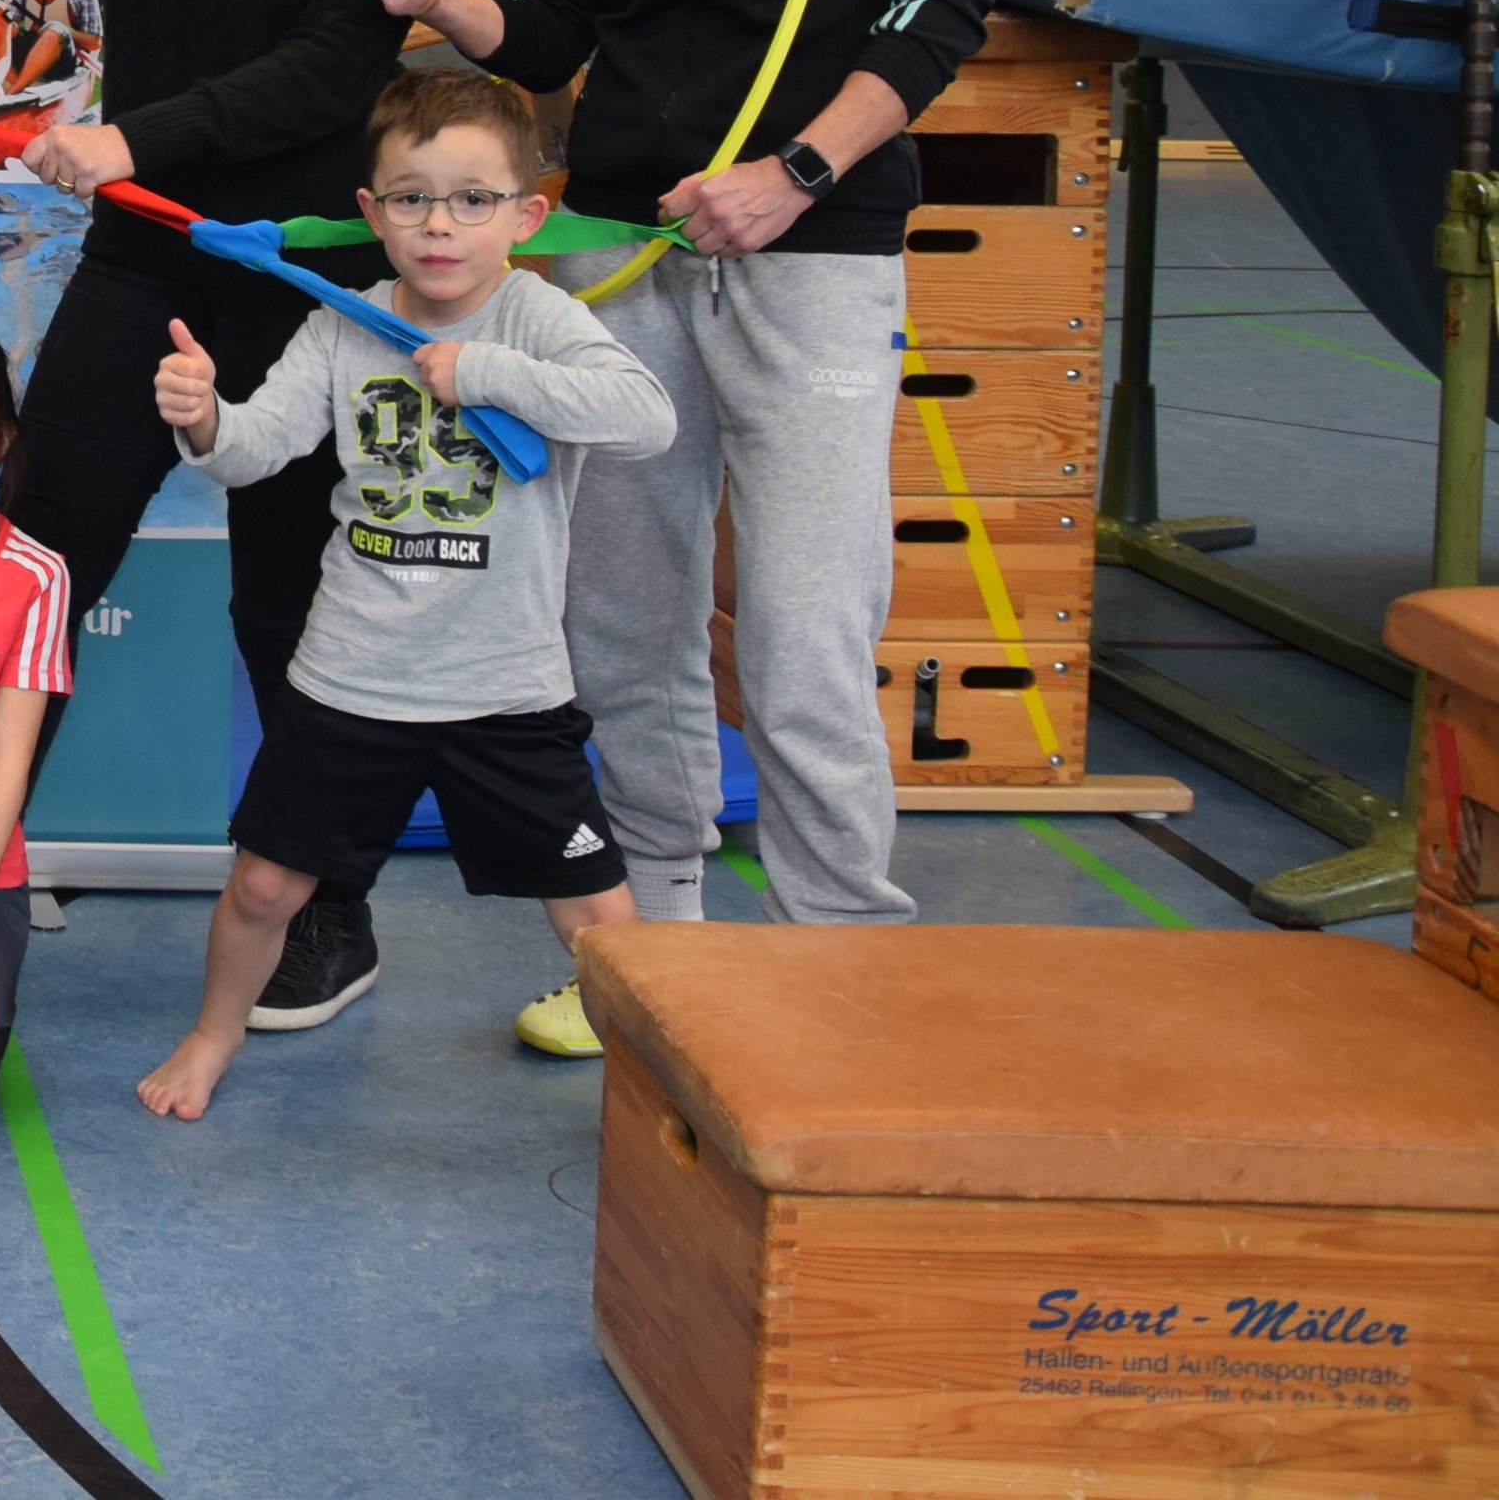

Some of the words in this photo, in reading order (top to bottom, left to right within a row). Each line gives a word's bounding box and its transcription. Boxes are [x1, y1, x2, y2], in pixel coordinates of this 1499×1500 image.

[352, 526, 393, 557] NEVER
[394, 538, 436, 559] LOOK
[439, 538, 481, 563] BACK
[84, 596, 134, 637] ür
[563, 838, 606, 859] adidas
[1028, 1289, 1180, 1342] Sport
[1226, 1296, 1409, 1347] Möller
[1025, 1348, 1112, 1371] Hallen-
[1122, 1353, 1170, 1375] und
[1019, 1376, 1082, 1396] 25462
